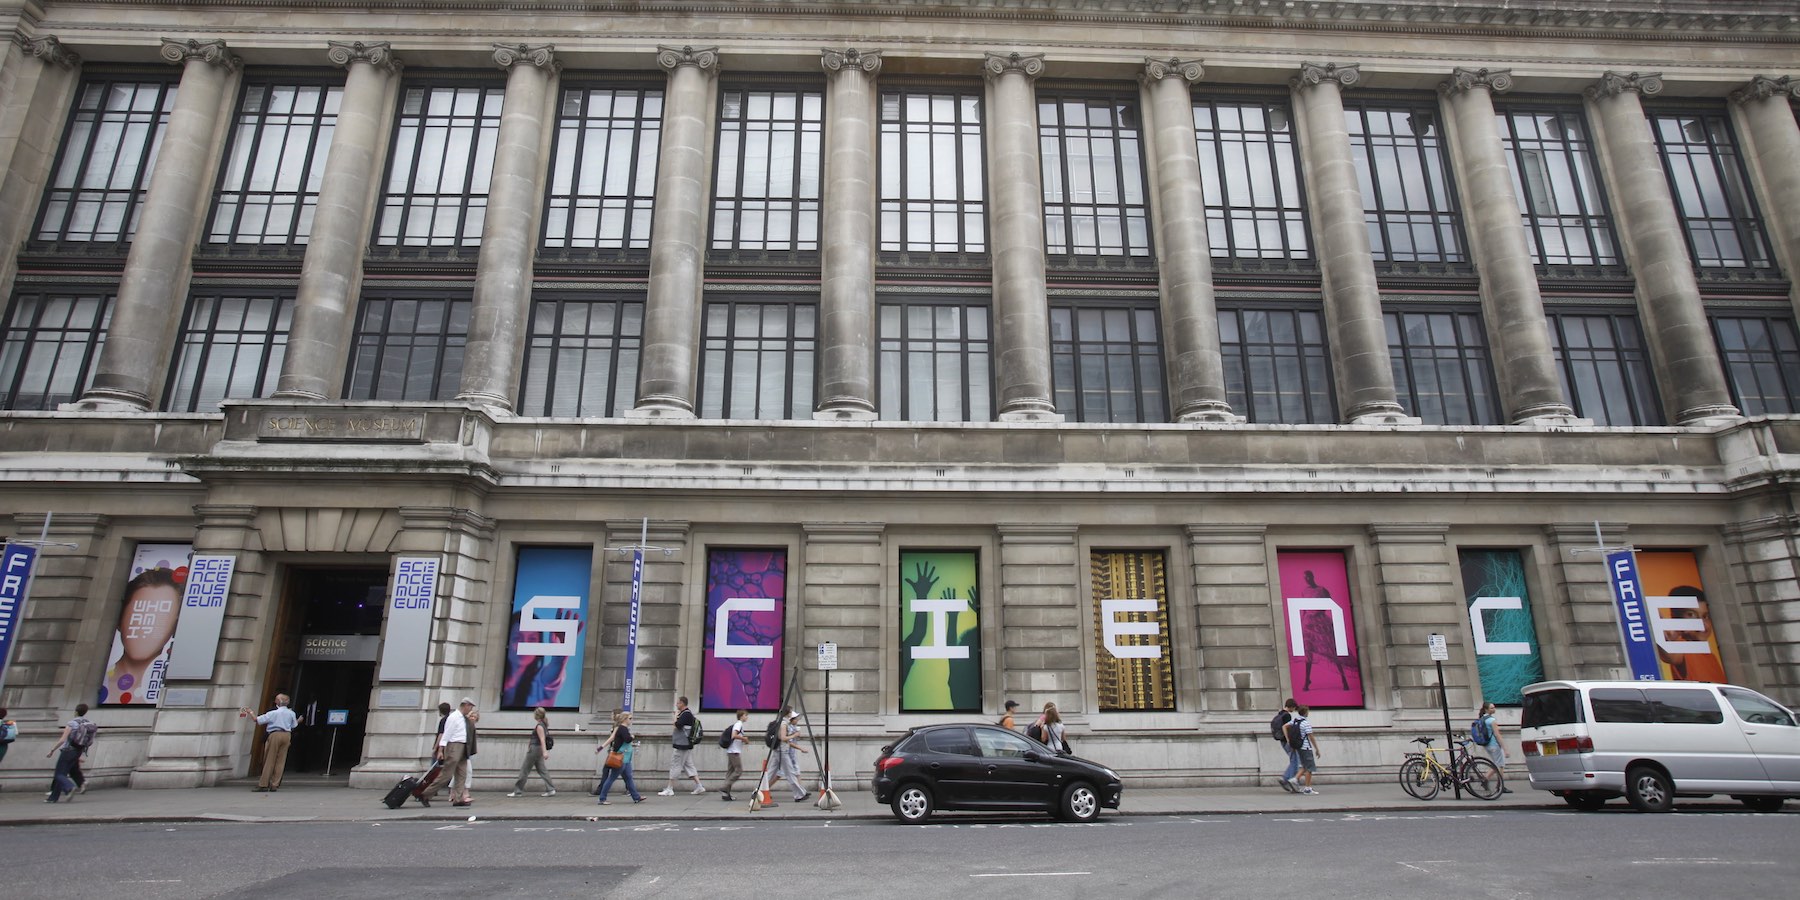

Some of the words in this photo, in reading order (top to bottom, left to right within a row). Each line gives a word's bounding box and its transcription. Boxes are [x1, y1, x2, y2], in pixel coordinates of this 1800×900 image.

[269, 417, 337, 431] SCIENCE
[347, 418, 416, 432] MUSEUM
[133, 600, 172, 612] WHO
[1615, 559, 1646, 642] FREE
[130, 613, 155, 625] AM
[126, 626, 153, 639] I?
[306, 636, 348, 647] science
[304, 647, 346, 656] museum
